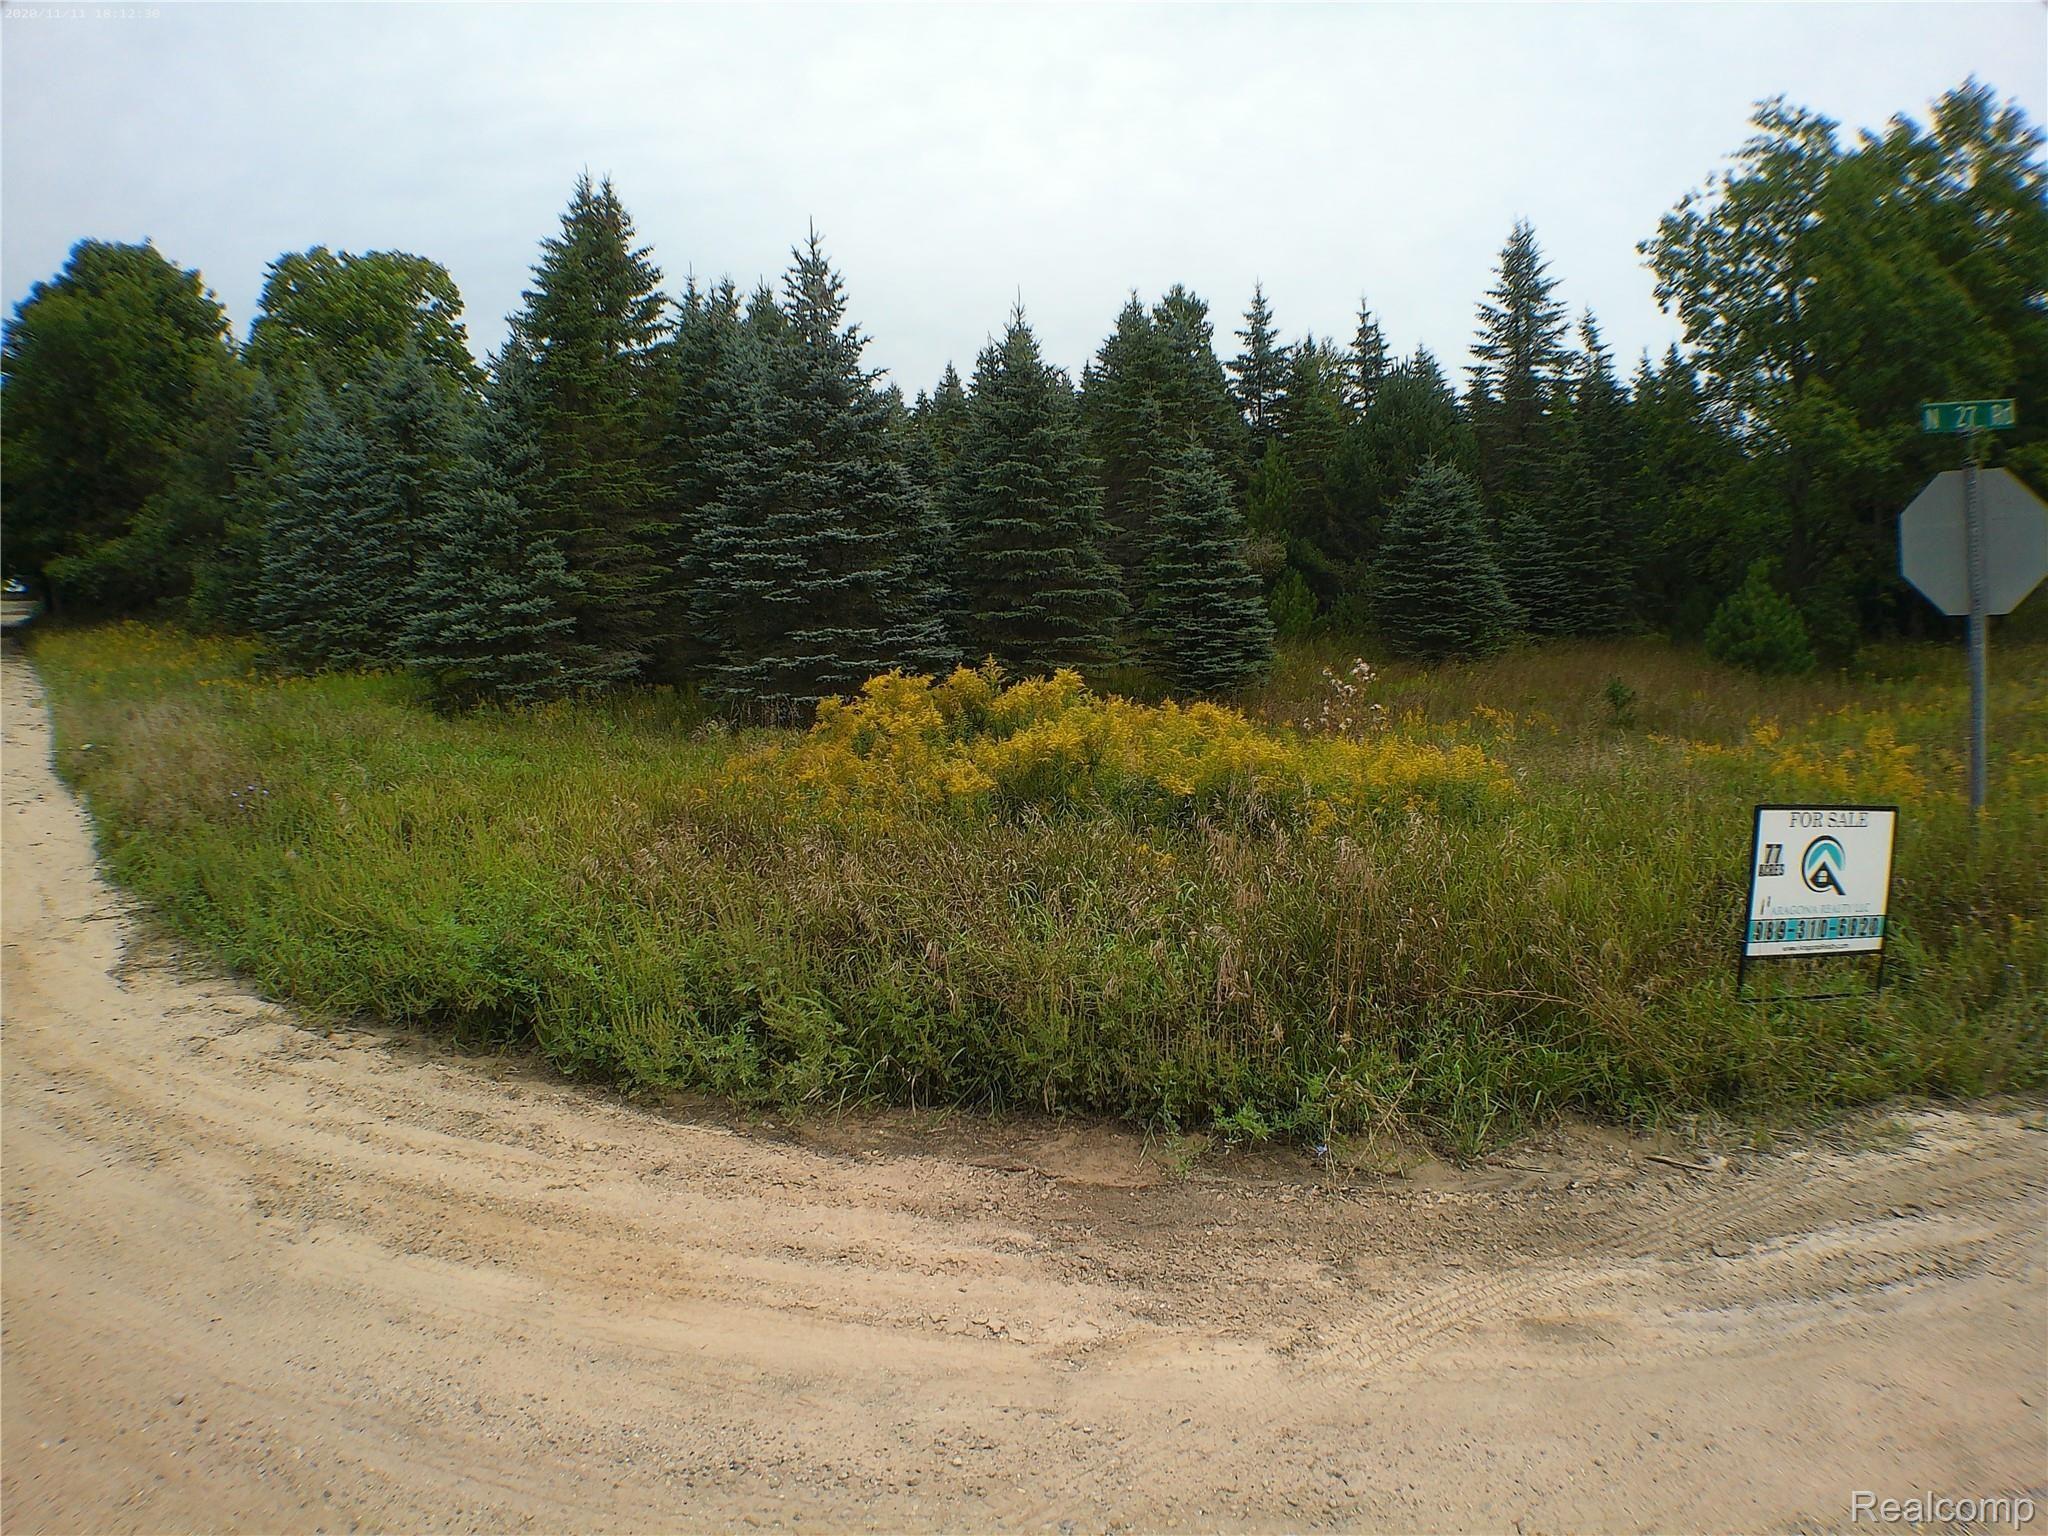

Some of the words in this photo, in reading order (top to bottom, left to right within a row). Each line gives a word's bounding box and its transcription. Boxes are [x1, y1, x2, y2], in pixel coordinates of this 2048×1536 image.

[1954, 405, 1978, 430] 27
[1788, 811, 1823, 828] FOR
[1827, 811, 1869, 828] SALE
[1762, 843, 1783, 864] 77
[1758, 863, 1785, 877] ACRES
